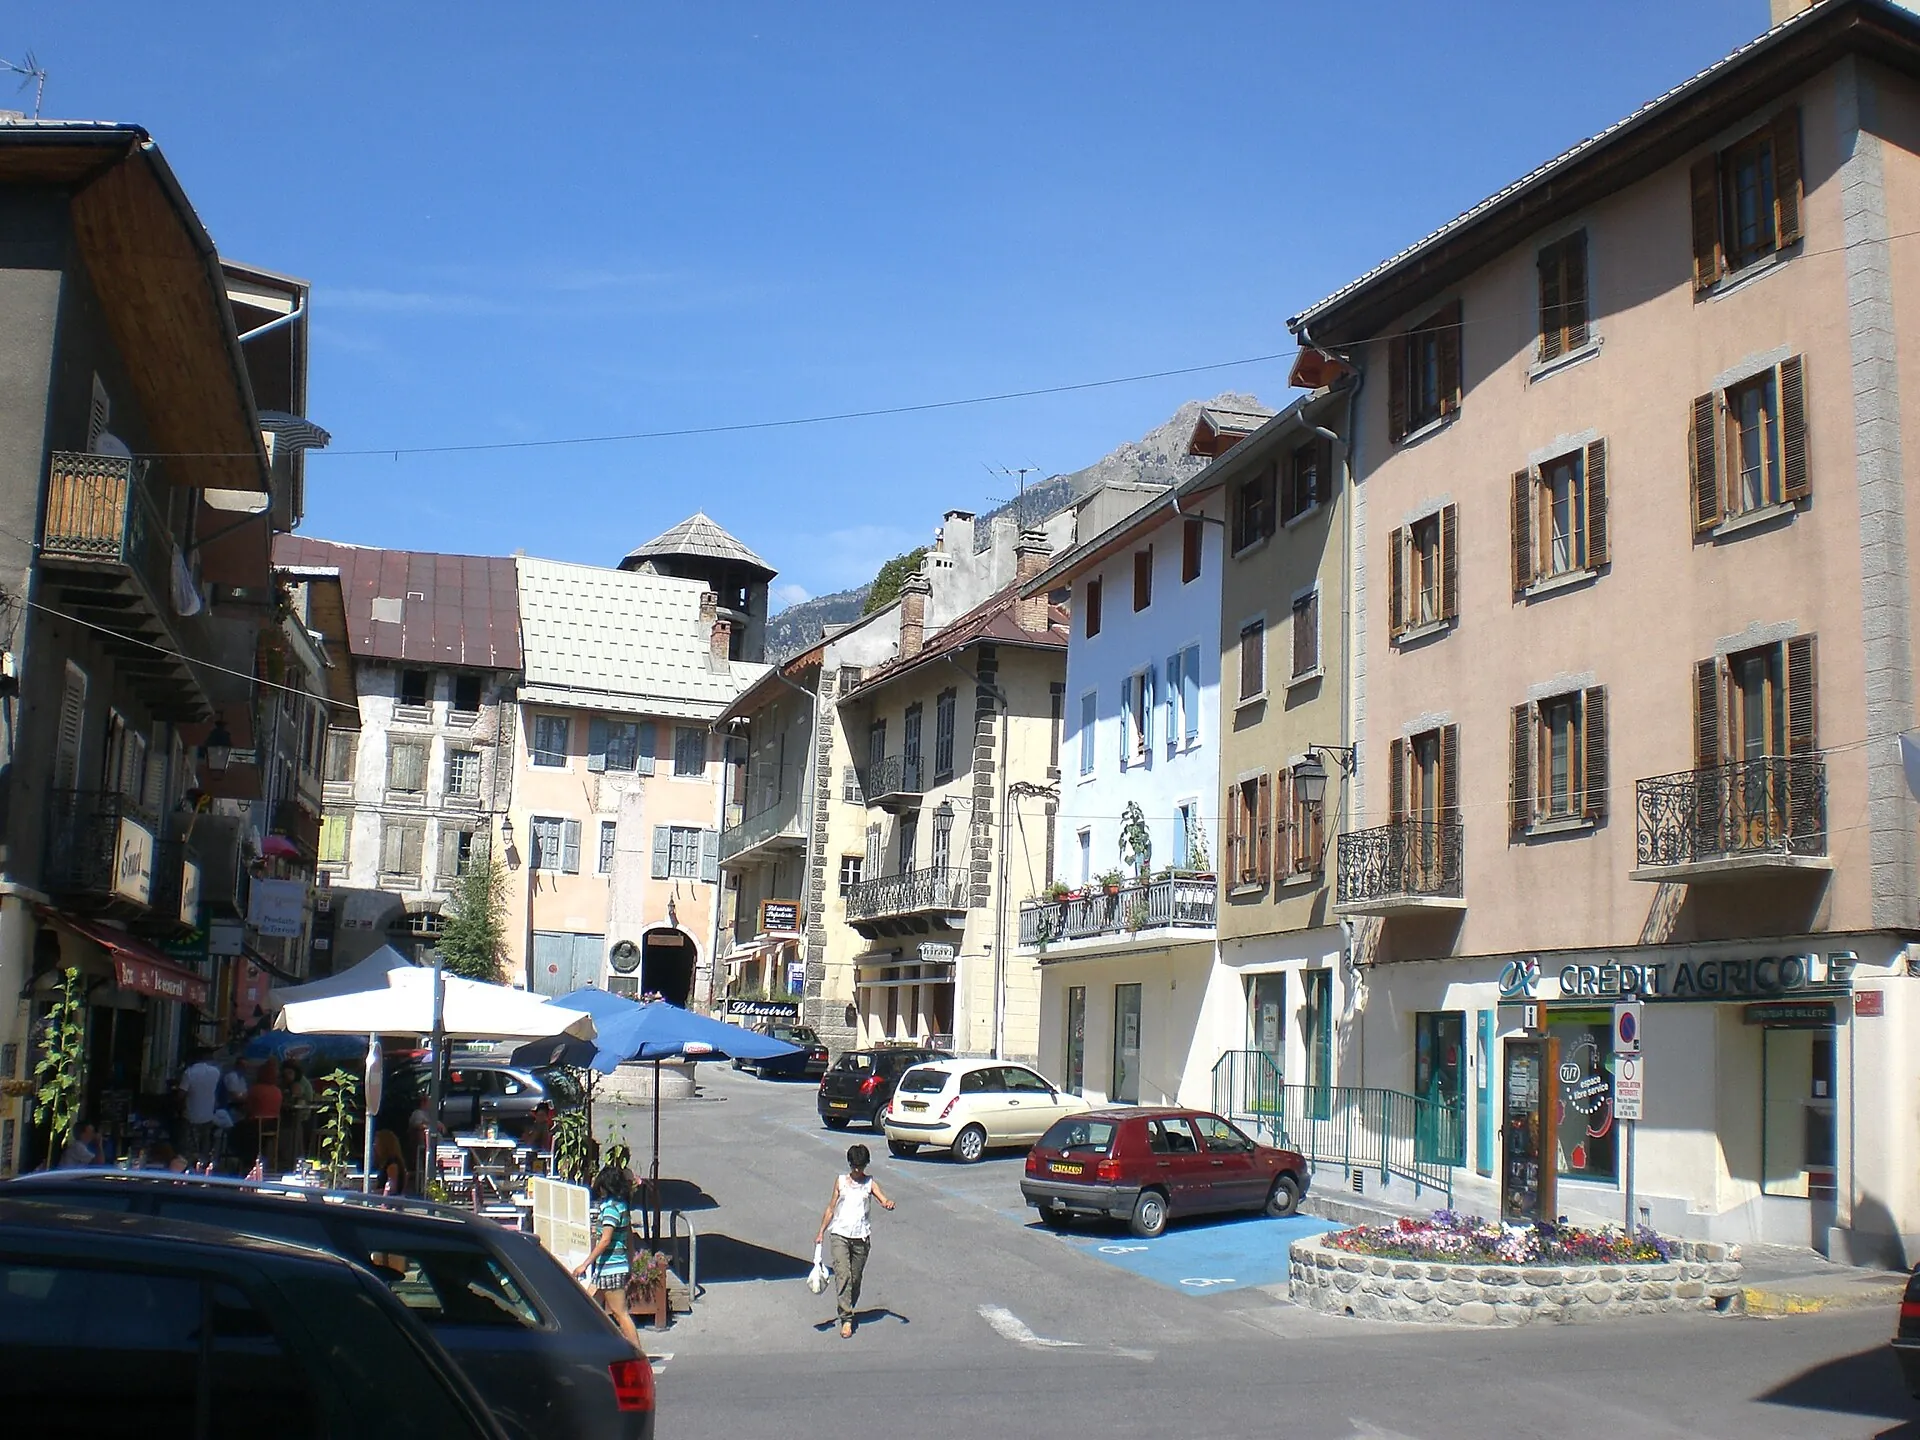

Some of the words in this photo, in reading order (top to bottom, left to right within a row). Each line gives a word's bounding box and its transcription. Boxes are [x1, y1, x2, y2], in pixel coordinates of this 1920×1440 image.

[1559, 958, 1666, 996] CRÉDIT
[1672, 951, 1858, 994] AGRICOLE
[729, 1001, 796, 1017] Librairie
[1796, 1009, 1827, 1017] BILLETS
[1580, 1076, 1601, 1089] espace
[1574, 1088, 1588, 1100] libre
[1588, 1083, 1609, 1096] service
